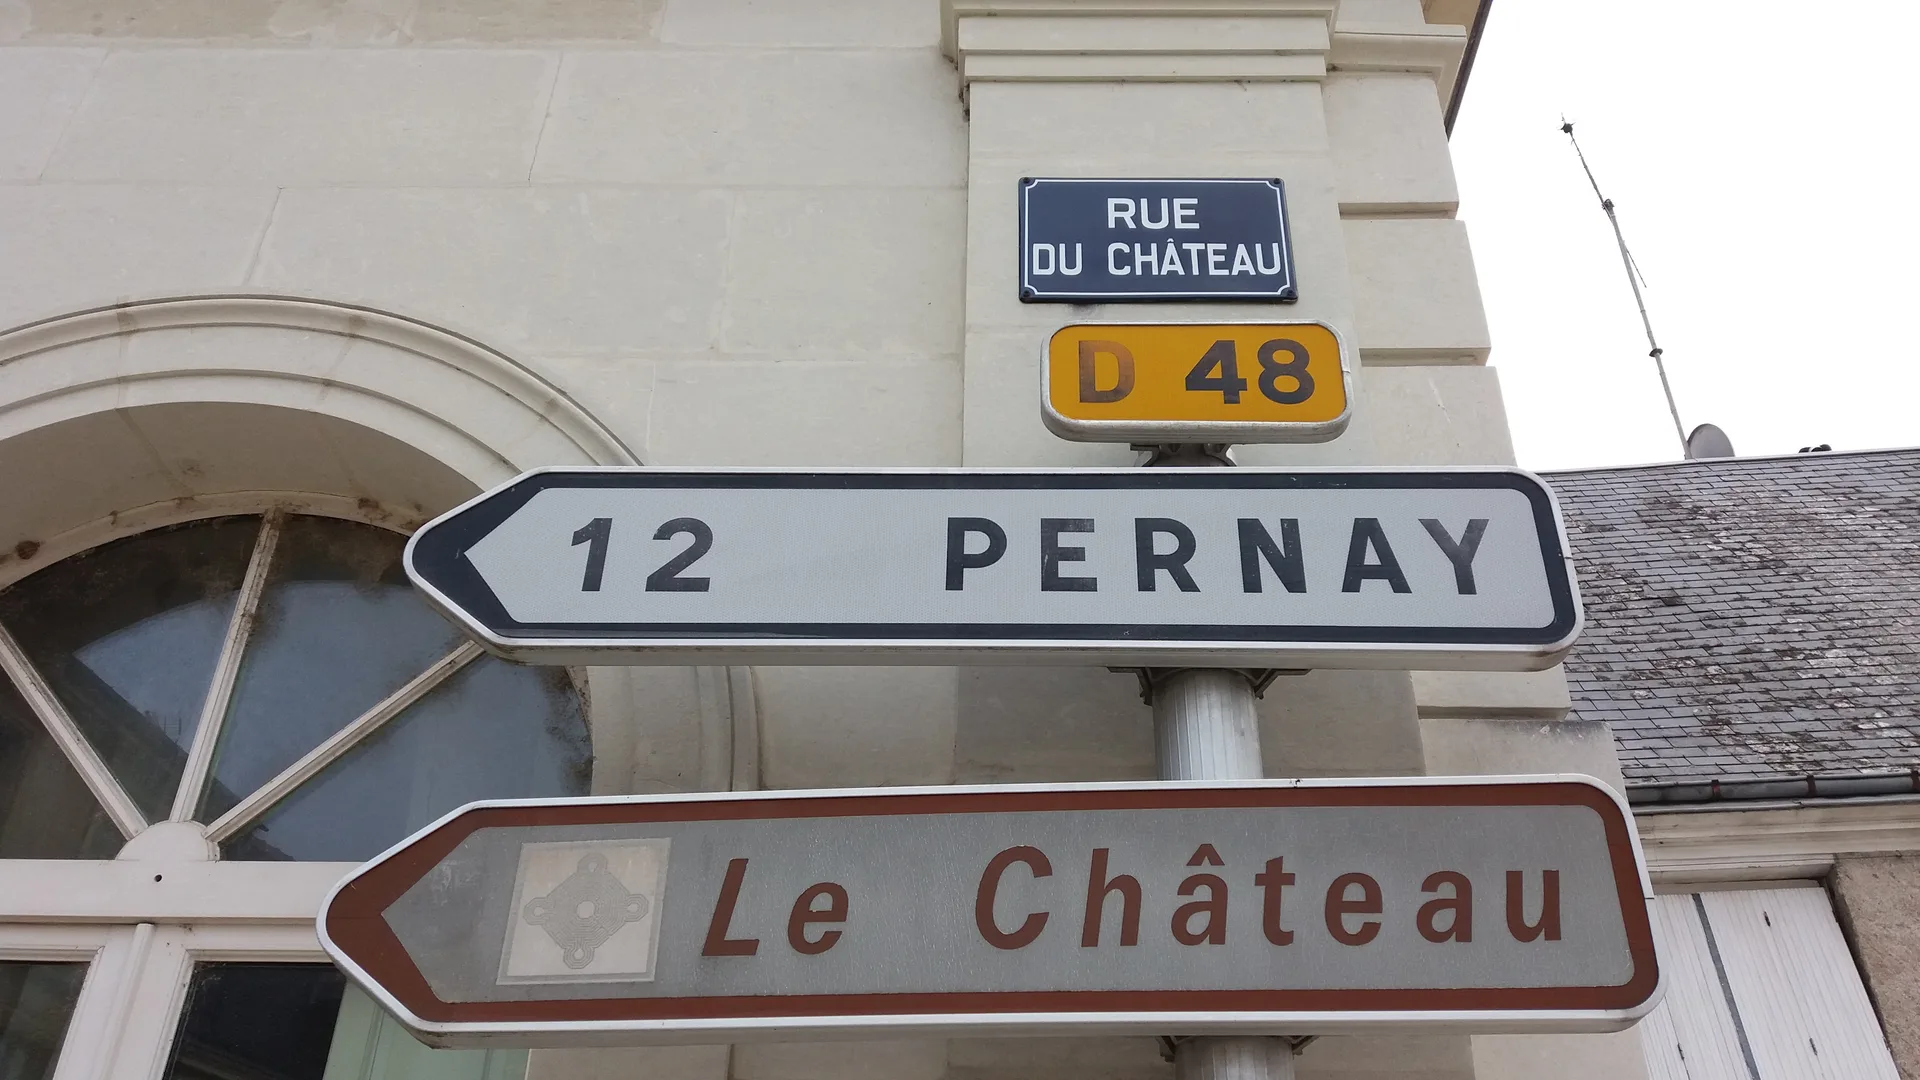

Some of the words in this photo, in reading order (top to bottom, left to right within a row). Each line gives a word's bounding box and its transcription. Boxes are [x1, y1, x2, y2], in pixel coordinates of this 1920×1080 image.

[1107, 197, 1200, 230] RUE
[1032, 242, 1083, 276] DU
[1107, 238, 1281, 276] CHÂTEAU
[1078, 340, 1135, 404] D
[1184, 338, 1315, 405] 48
[570, 516, 714, 593] 12
[945, 517, 1490, 595] PERNAY
[701, 857, 850, 956] Le
[974, 843, 1562, 950] Château
